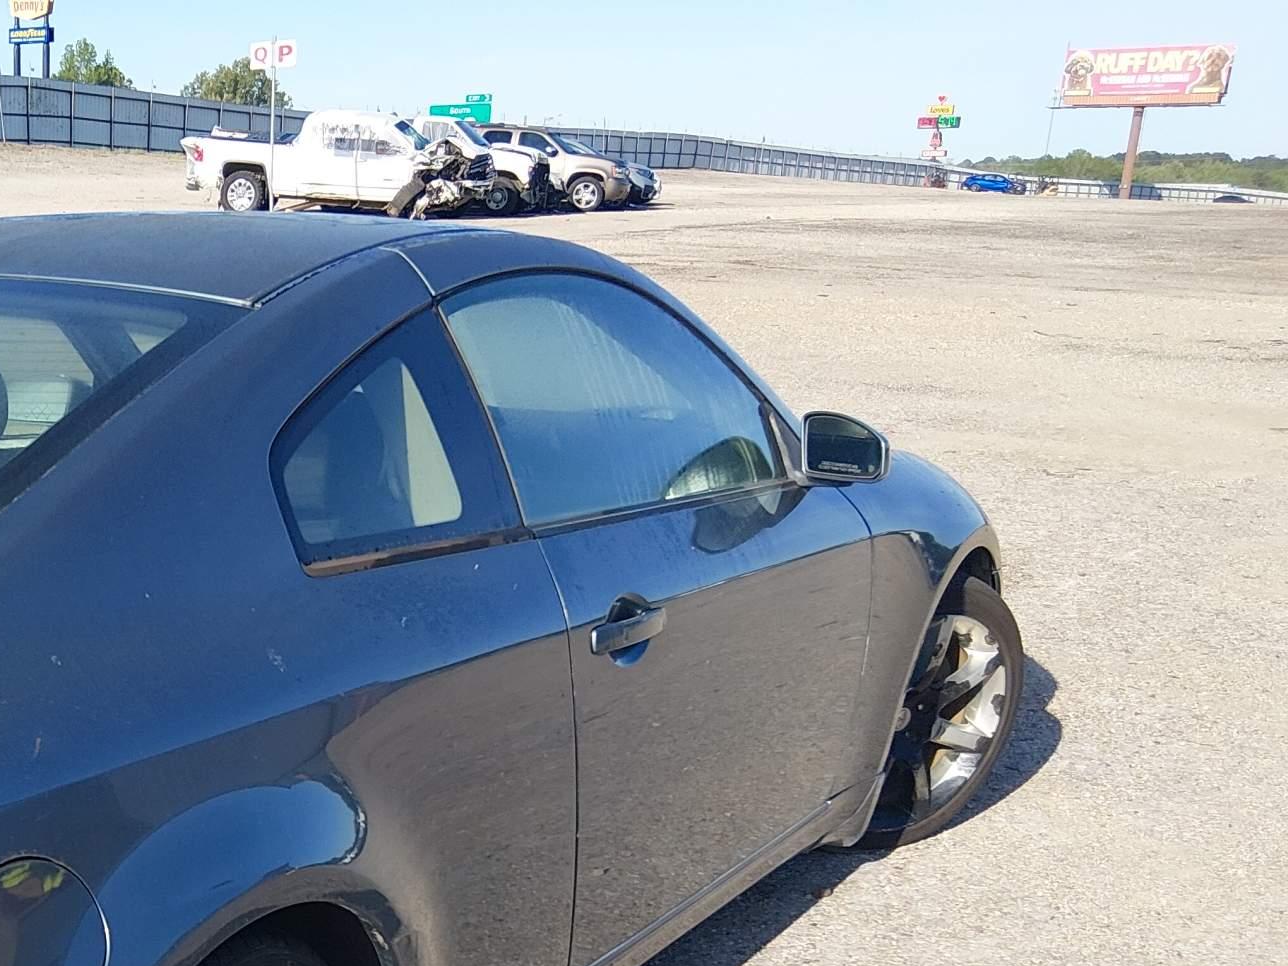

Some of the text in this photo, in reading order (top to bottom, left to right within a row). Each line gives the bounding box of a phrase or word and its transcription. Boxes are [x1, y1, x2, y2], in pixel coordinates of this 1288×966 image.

[254, 46, 268, 64] Q
[278, 45, 293, 63] P
[1095, 49, 1199, 73] RUFF DAY?
